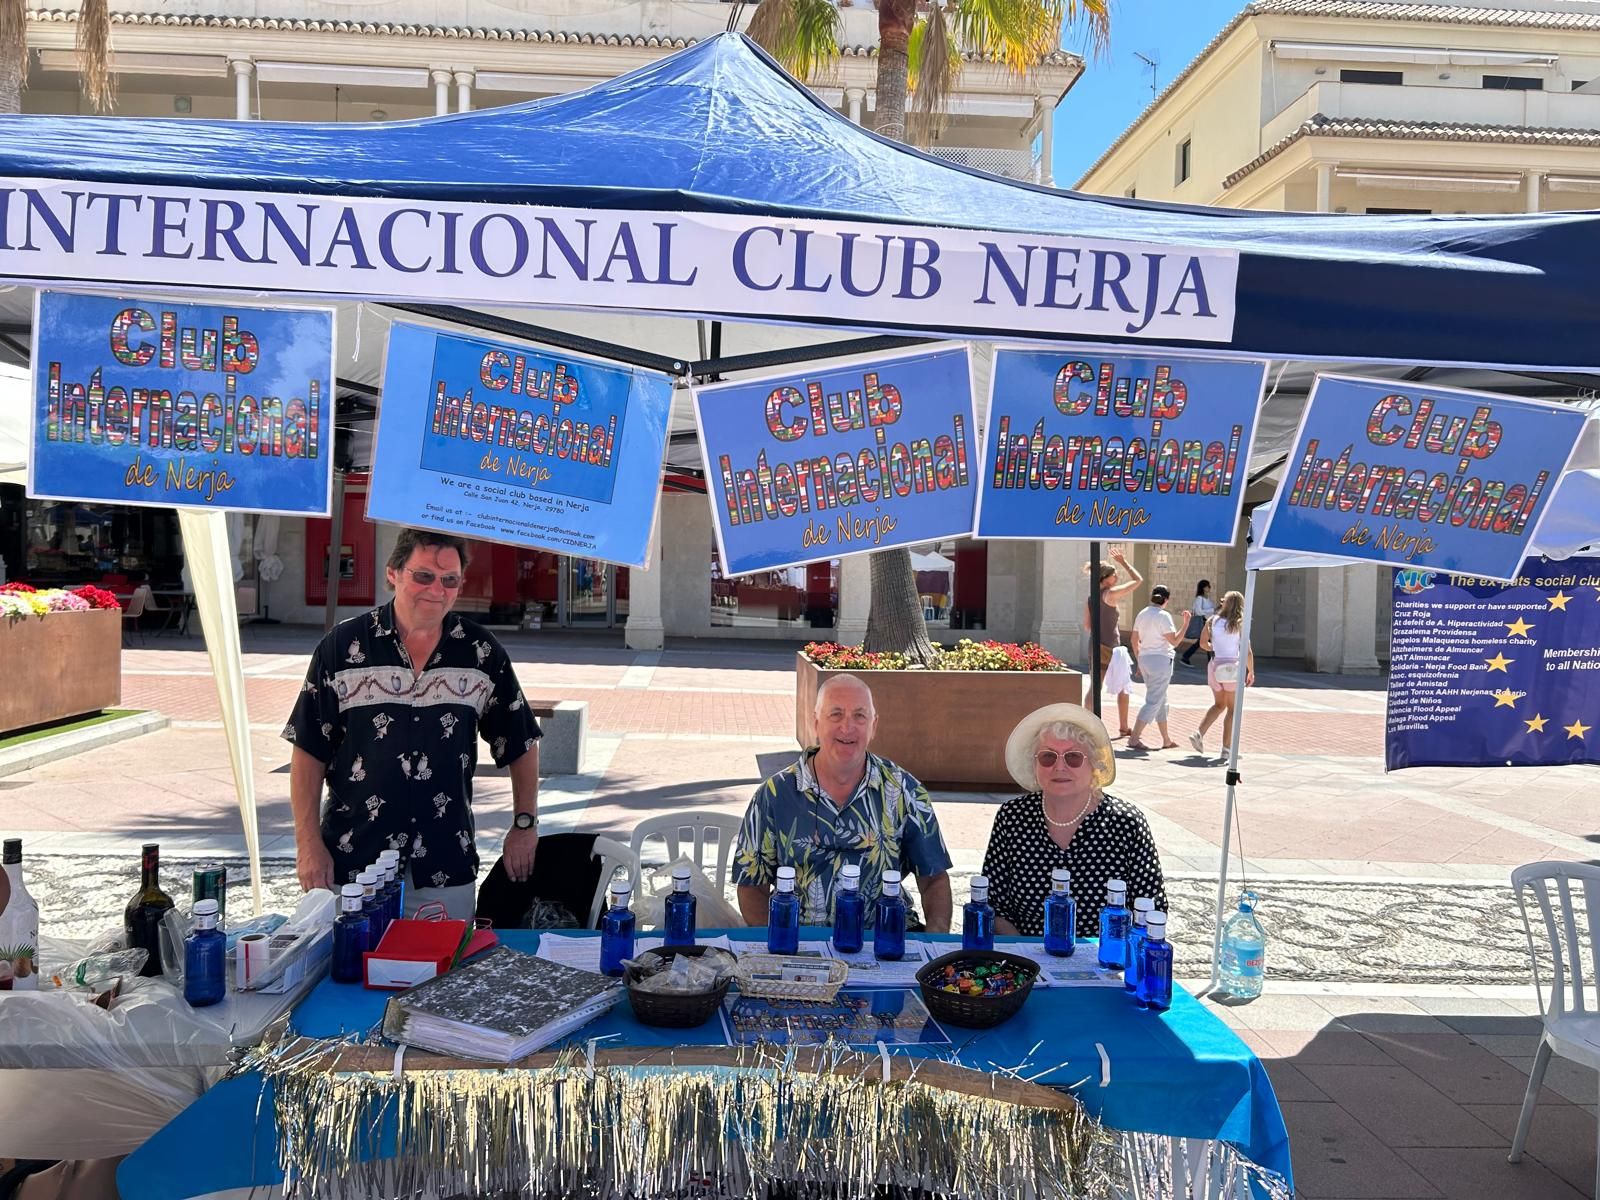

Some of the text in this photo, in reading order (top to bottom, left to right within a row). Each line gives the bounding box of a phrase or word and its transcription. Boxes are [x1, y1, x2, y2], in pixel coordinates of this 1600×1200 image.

[0, 187, 1218, 334] INTERNACIONAL CLUB NERJA
[109, 308, 260, 375] Club
[479, 350, 579, 406] Club
[1053, 360, 1188, 420] Club
[46, 362, 320, 460] Internacional
[431, 380, 618, 468] Internacional
[765, 372, 903, 443] Club
[1366, 394, 1503, 460] Club
[479, 452, 553, 484] de Nerja
[718, 413, 969, 527] Internacional
[993, 415, 1244, 498] Internacional
[124, 456, 236, 502] de Nerja
[440, 476, 455, 486] We
[458, 482, 472, 490] are
[484, 485, 507, 496] social
[509, 489, 525, 499] club
[529, 493, 553, 505] based
[556, 498, 563, 506] in
[566, 499, 590, 512] Nerja
[1287, 438, 1551, 536] Internacional
[425, 503, 443, 512] Email
[464, 491, 479, 500] Calle
[480, 493, 493, 501] San
[545, 504, 565, 515] 29780
[1055, 498, 1153, 536] de Nerja
[431, 513, 445, 523] find
[466, 519, 495, 531] Facebook
[802, 513, 899, 549] de Nerja
[1340, 520, 1439, 562] de Nerja
[1449, 574, 1475, 587] The
[1535, 575, 1576, 587] social
[1395, 601, 1429, 609] Charities
[1444, 603, 1476, 611] support
[1507, 603, 1547, 611] supported
[1447, 620, 1503, 628] Hiperactividad
[1509, 638, 1537, 646] charity
[1408, 672, 1459, 680] esquizofrenia
[1425, 663, 1446, 671] Nerja
[1546, 662, 1556, 671] to
[1557, 660, 1571, 670] all
[1435, 705, 1462, 713] Appeal
